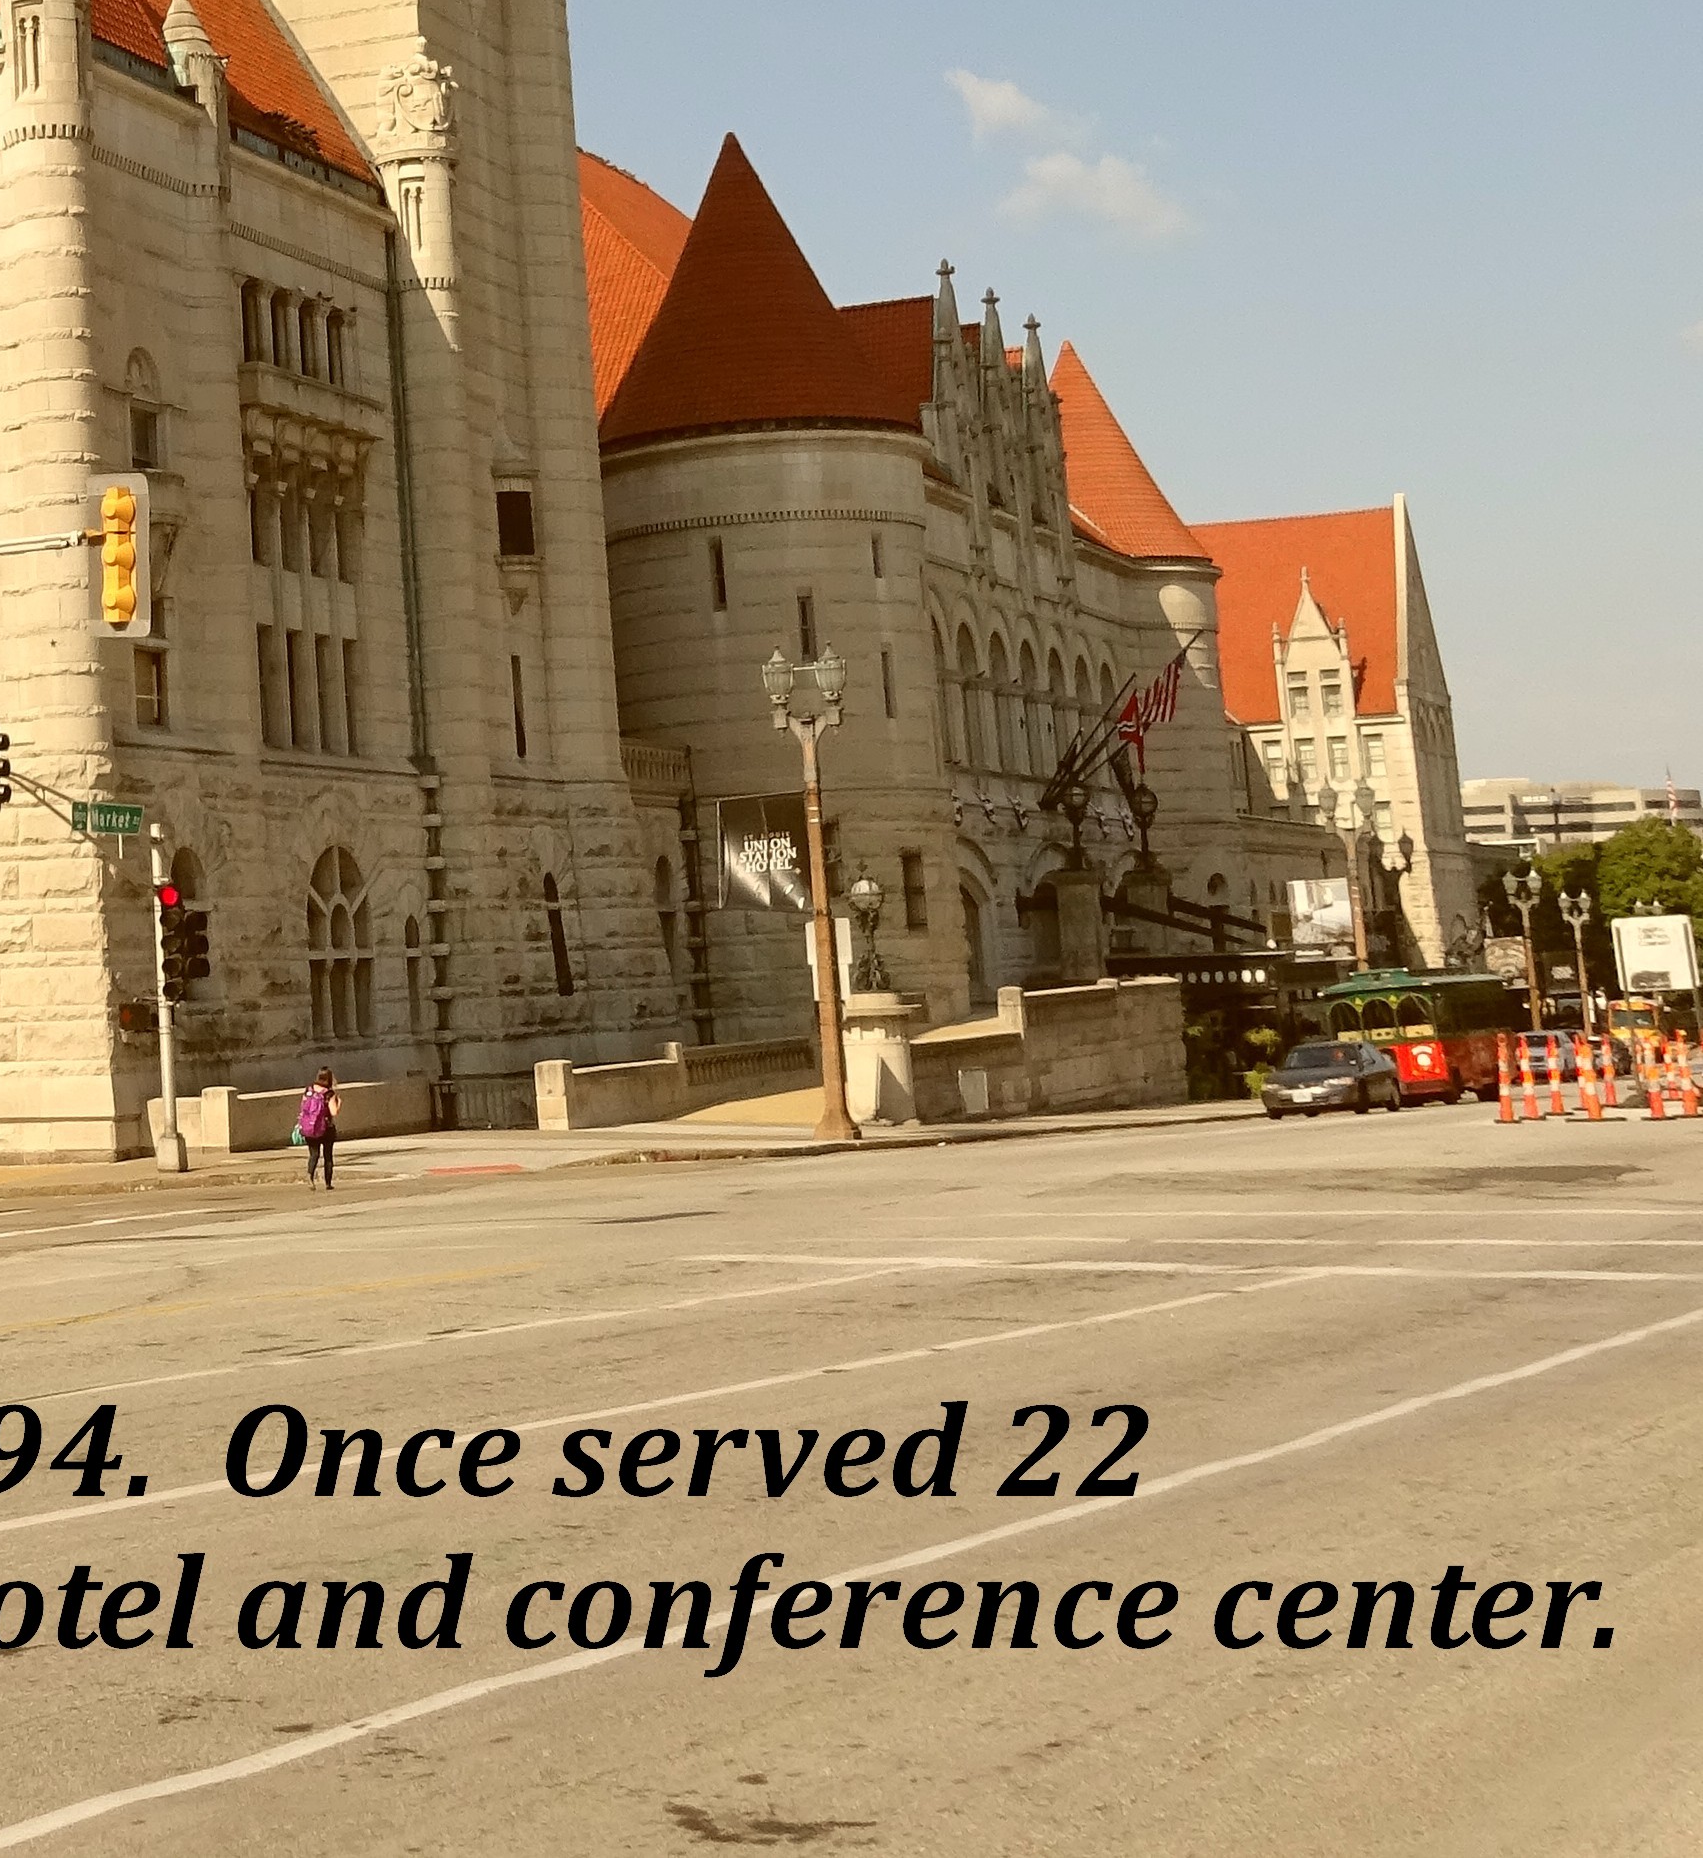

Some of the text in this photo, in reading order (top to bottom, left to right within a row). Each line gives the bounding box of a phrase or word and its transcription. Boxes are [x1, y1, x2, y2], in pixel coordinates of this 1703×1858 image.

[91, 809, 130, 828] Market
[744, 837, 791, 852] UNION
[739, 847, 797, 863] STATION
[745, 858, 793, 873] HOTEL
